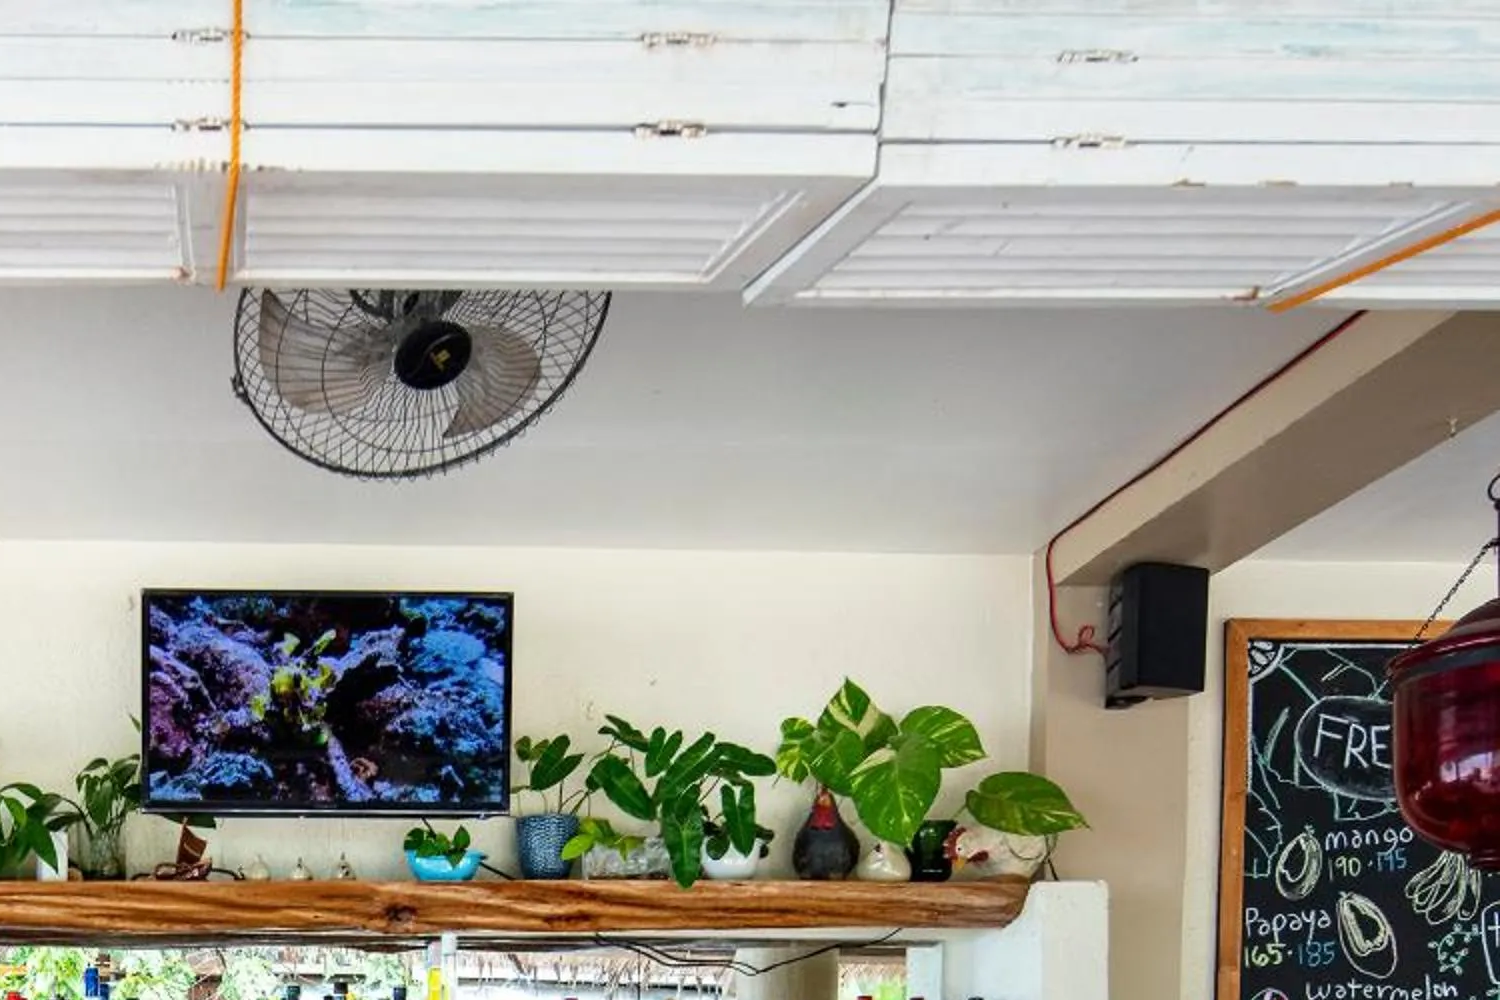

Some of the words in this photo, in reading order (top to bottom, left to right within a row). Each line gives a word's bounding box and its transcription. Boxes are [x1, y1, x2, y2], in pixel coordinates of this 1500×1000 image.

[1313, 713, 1394, 769] FRE
[1325, 825, 1414, 854] mango
[1328, 857, 1362, 882] 190
[1244, 944, 1287, 968] 165
